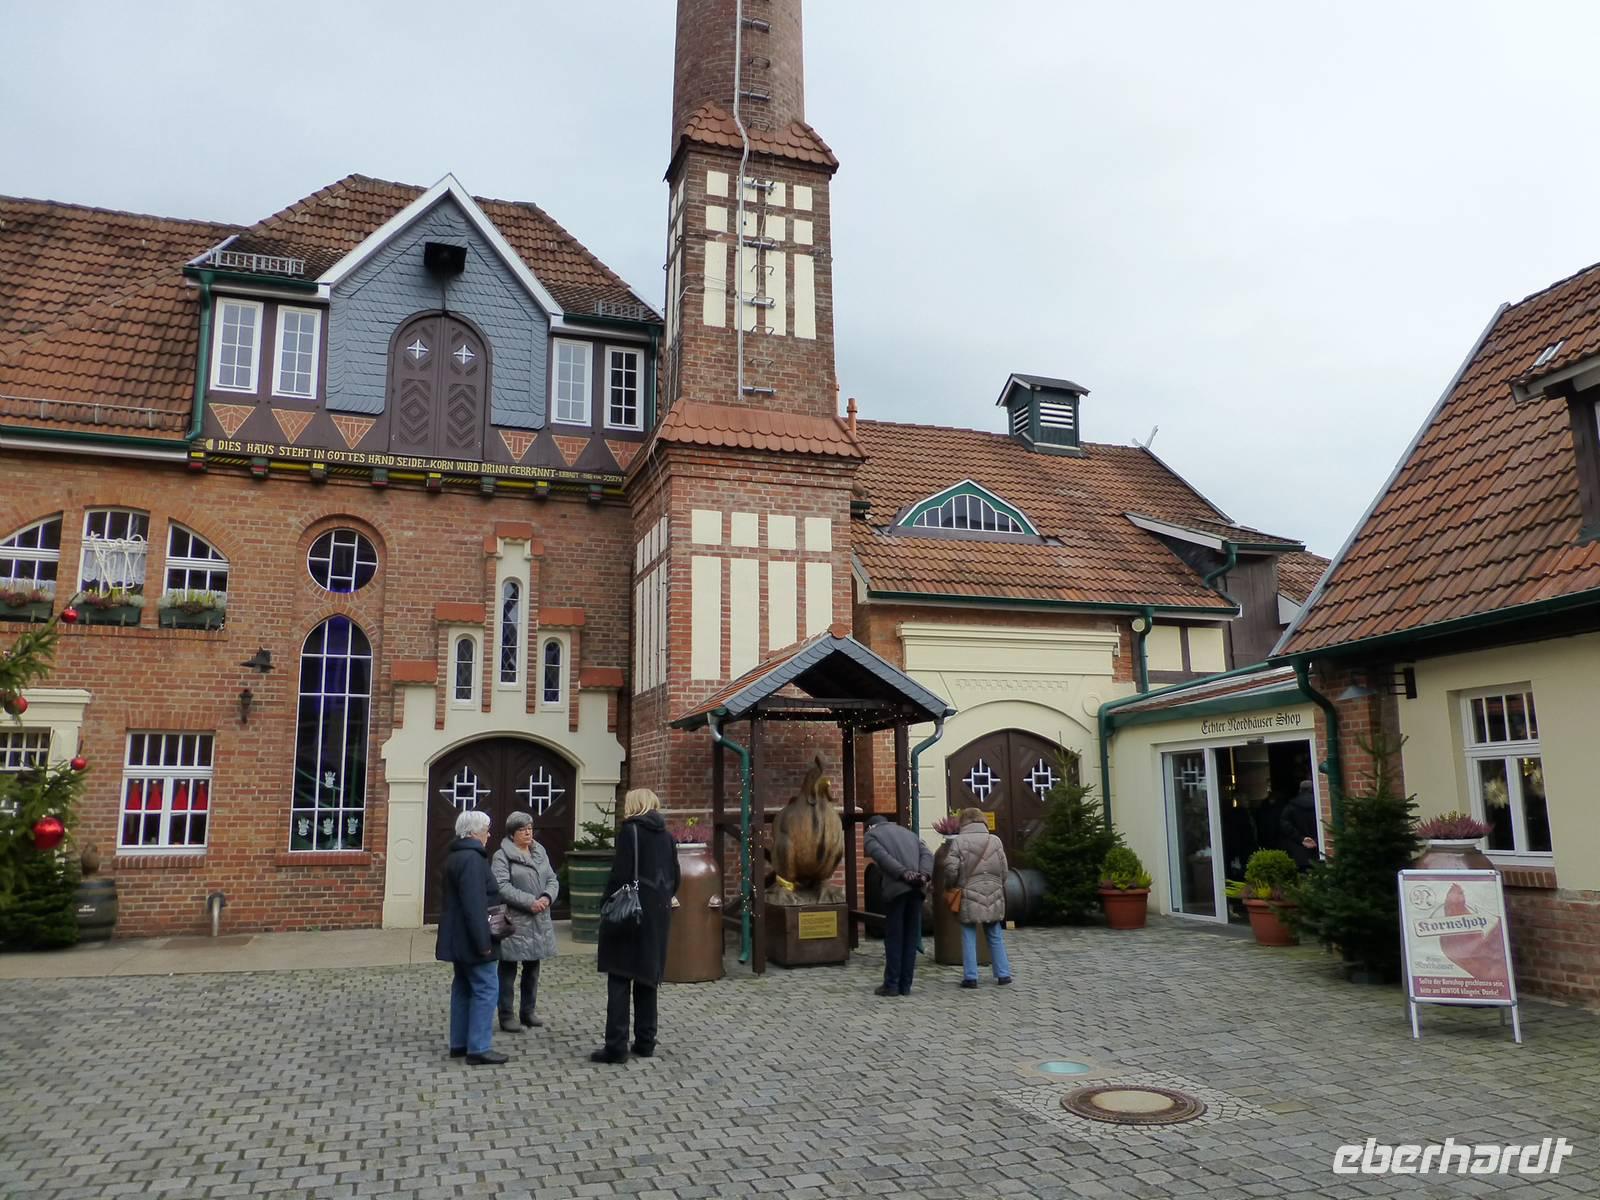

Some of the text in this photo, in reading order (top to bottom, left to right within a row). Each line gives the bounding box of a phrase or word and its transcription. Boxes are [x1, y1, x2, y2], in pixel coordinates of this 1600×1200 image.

[218, 440, 241, 451] DIES
[247, 443, 275, 454] HAUS
[279, 446, 311, 458] STEHT
[313, 449, 324, 459] IN
[327, 451, 365, 463] GOTTES
[368, 454, 395, 465] HAND
[457, 461, 479, 472] WIRD
[481, 463, 508, 474] DRINN
[1201, 712, 1301, 735] Echter Nordhäuser Shop
[1417, 916, 1487, 933] Kornshop
